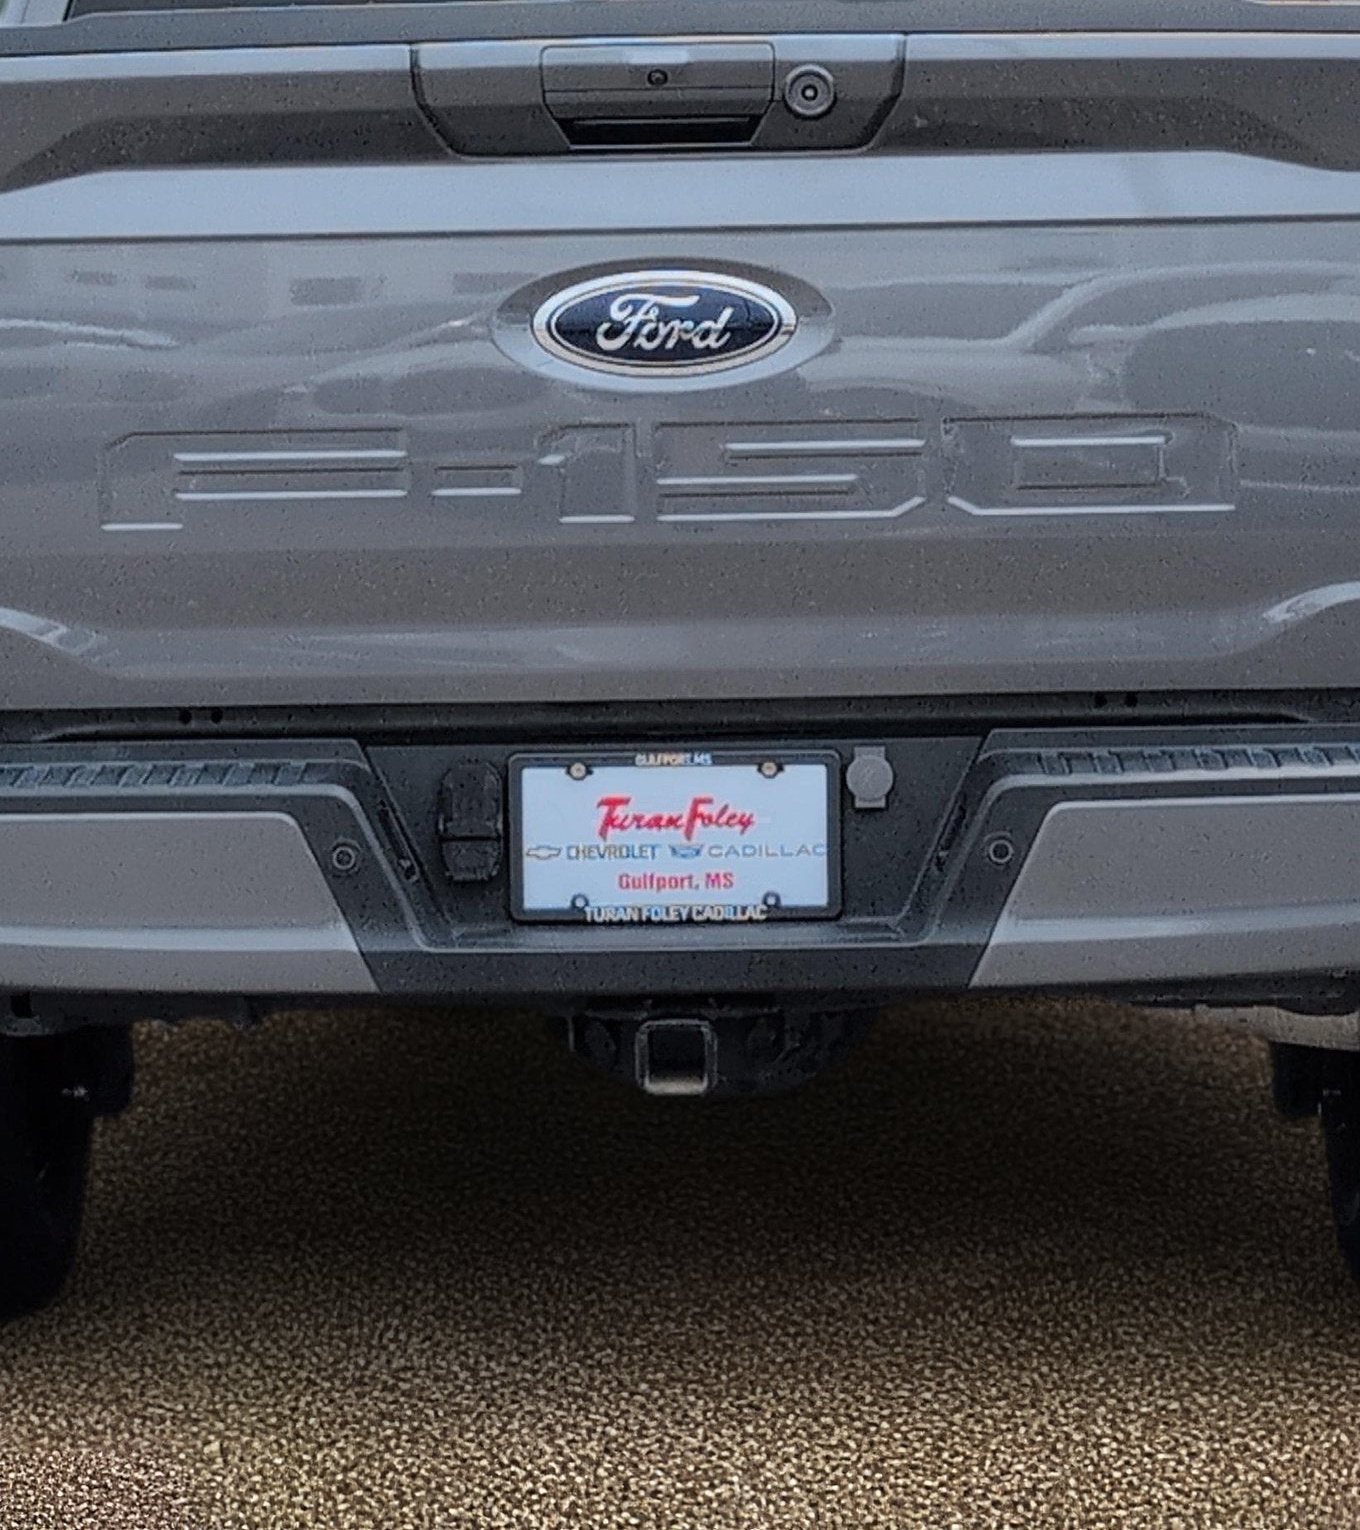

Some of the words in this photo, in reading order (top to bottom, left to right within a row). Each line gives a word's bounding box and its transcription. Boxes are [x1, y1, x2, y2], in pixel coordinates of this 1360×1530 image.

[596, 293, 735, 351] Ford
[100, 410, 1237, 531] F-150
[566, 843, 660, 861] CHEVROLET
[707, 843, 827, 858] CADILLAC
[617, 872, 700, 892] Gulfport,
[704, 872, 736, 890] MS
[584, 906, 639, 922] TURAN
[641, 905, 690, 922] FOLEY
[692, 904, 768, 921] CADILLAC
